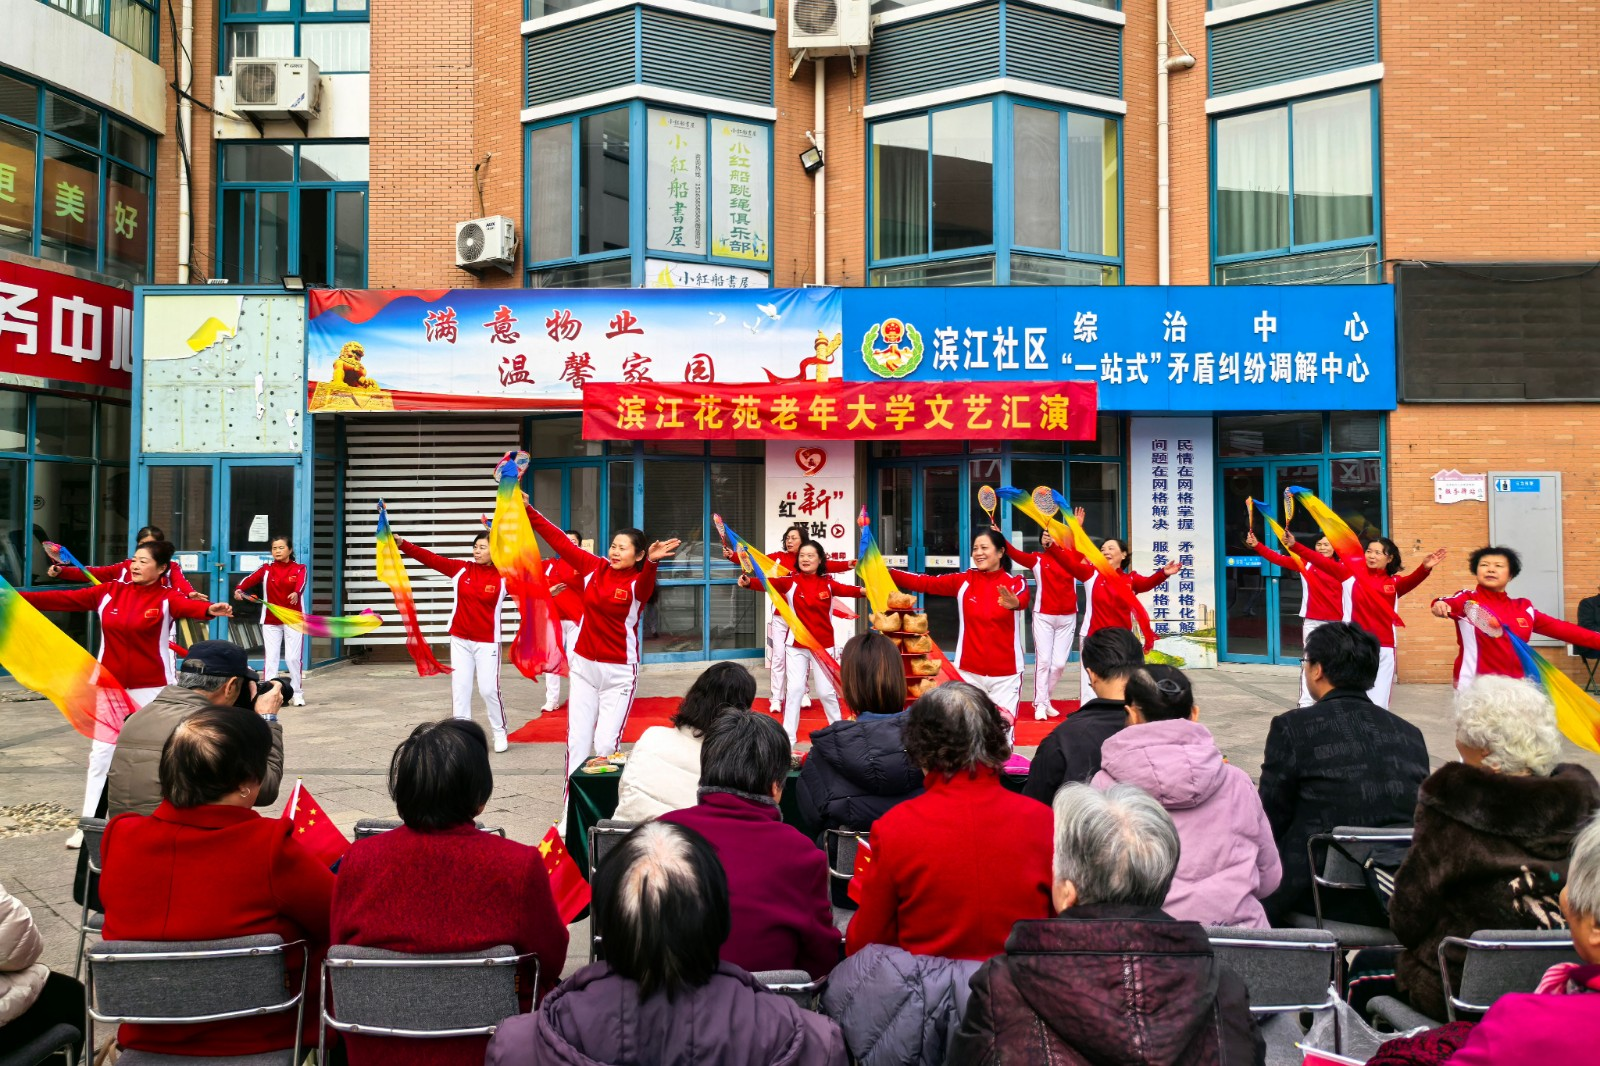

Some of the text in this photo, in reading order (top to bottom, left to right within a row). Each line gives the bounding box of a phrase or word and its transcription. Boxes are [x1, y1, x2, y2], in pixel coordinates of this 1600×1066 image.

[424, 305, 645, 345] 满意物业
[1073, 311, 1369, 343] 综治中心
[933, 326, 1049, 372] 滨江社区
[1062, 351, 1370, 385] “一站式”矛盾纠纷调解中心
[498, 352, 715, 390] 温馨家园
[617, 394, 1069, 431] 滨江花苑老年大学文艺汇演
[1151, 439, 1170, 634] 问题在网格解决 服务网格开展
[1177, 439, 1196, 634] 民情在网格掌握 矛盾在网格化解
